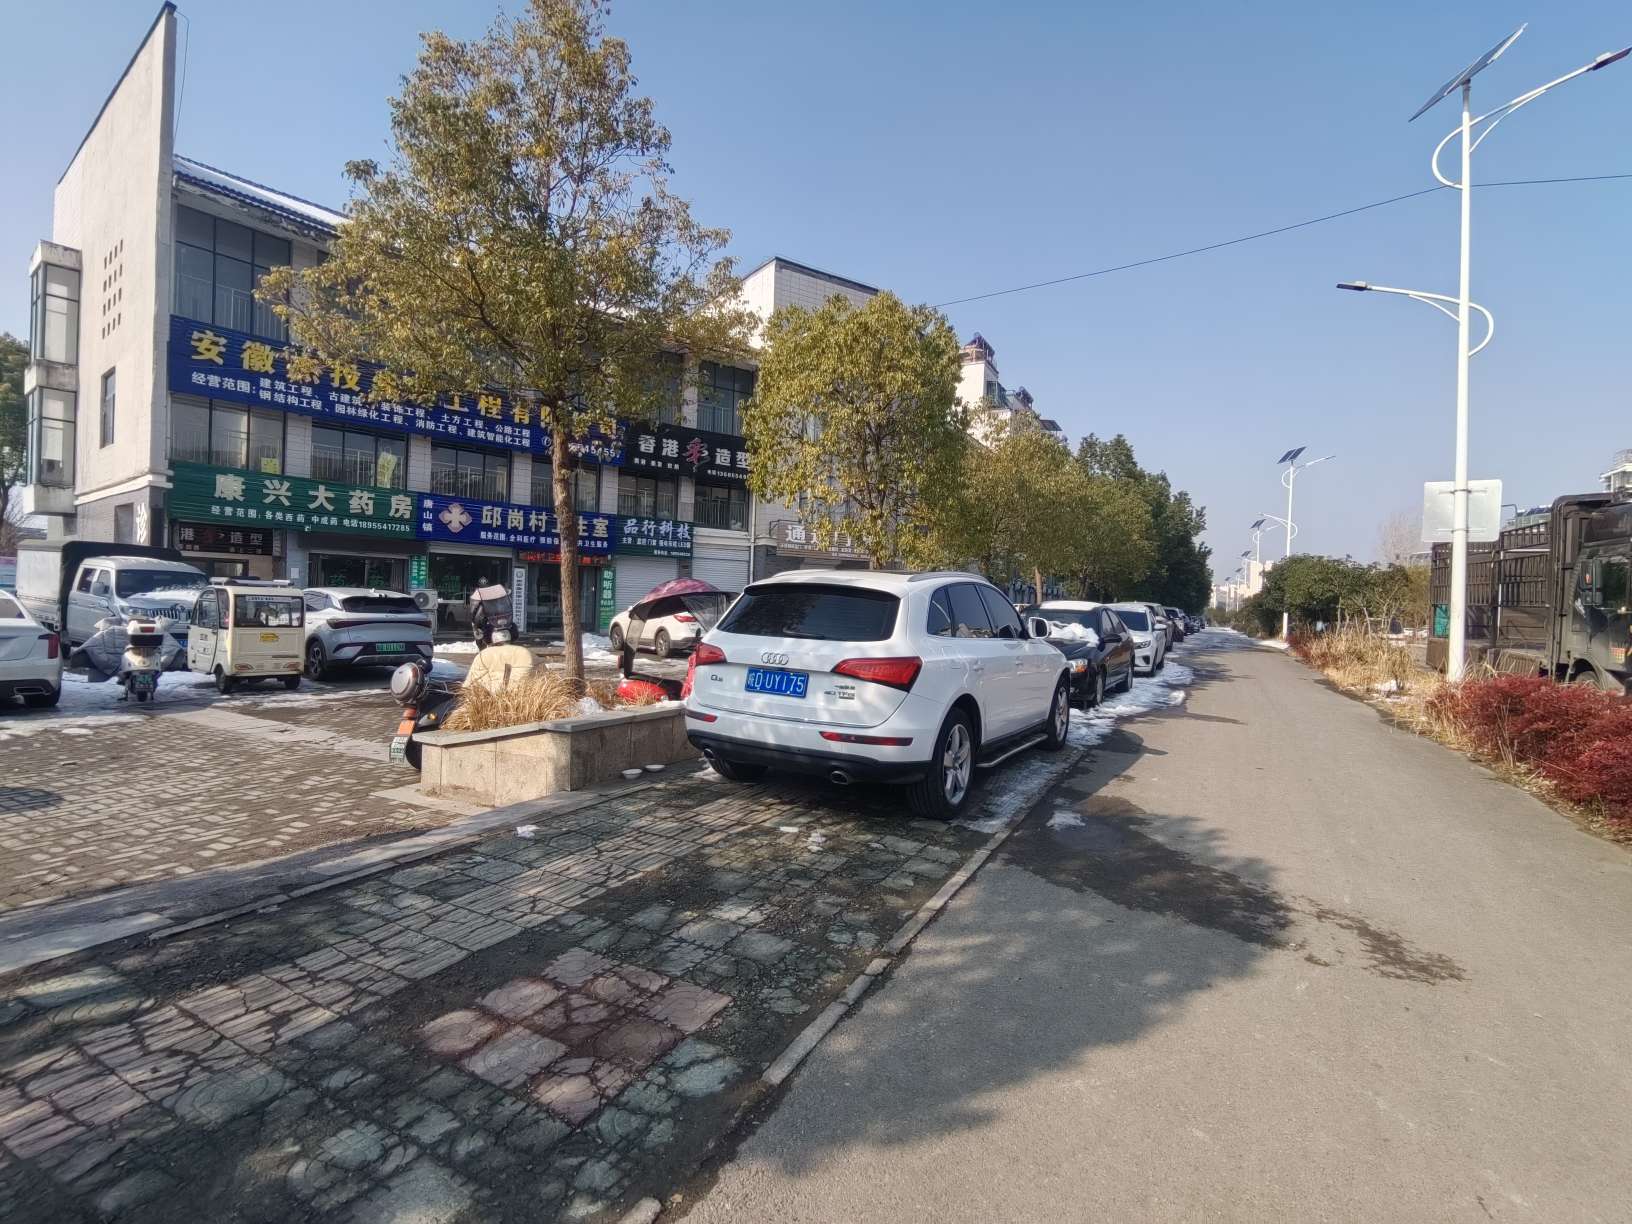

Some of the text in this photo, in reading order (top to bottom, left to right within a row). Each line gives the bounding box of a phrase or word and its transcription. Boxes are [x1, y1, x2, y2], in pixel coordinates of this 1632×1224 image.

[213, 473, 413, 519] 康兴大药房
